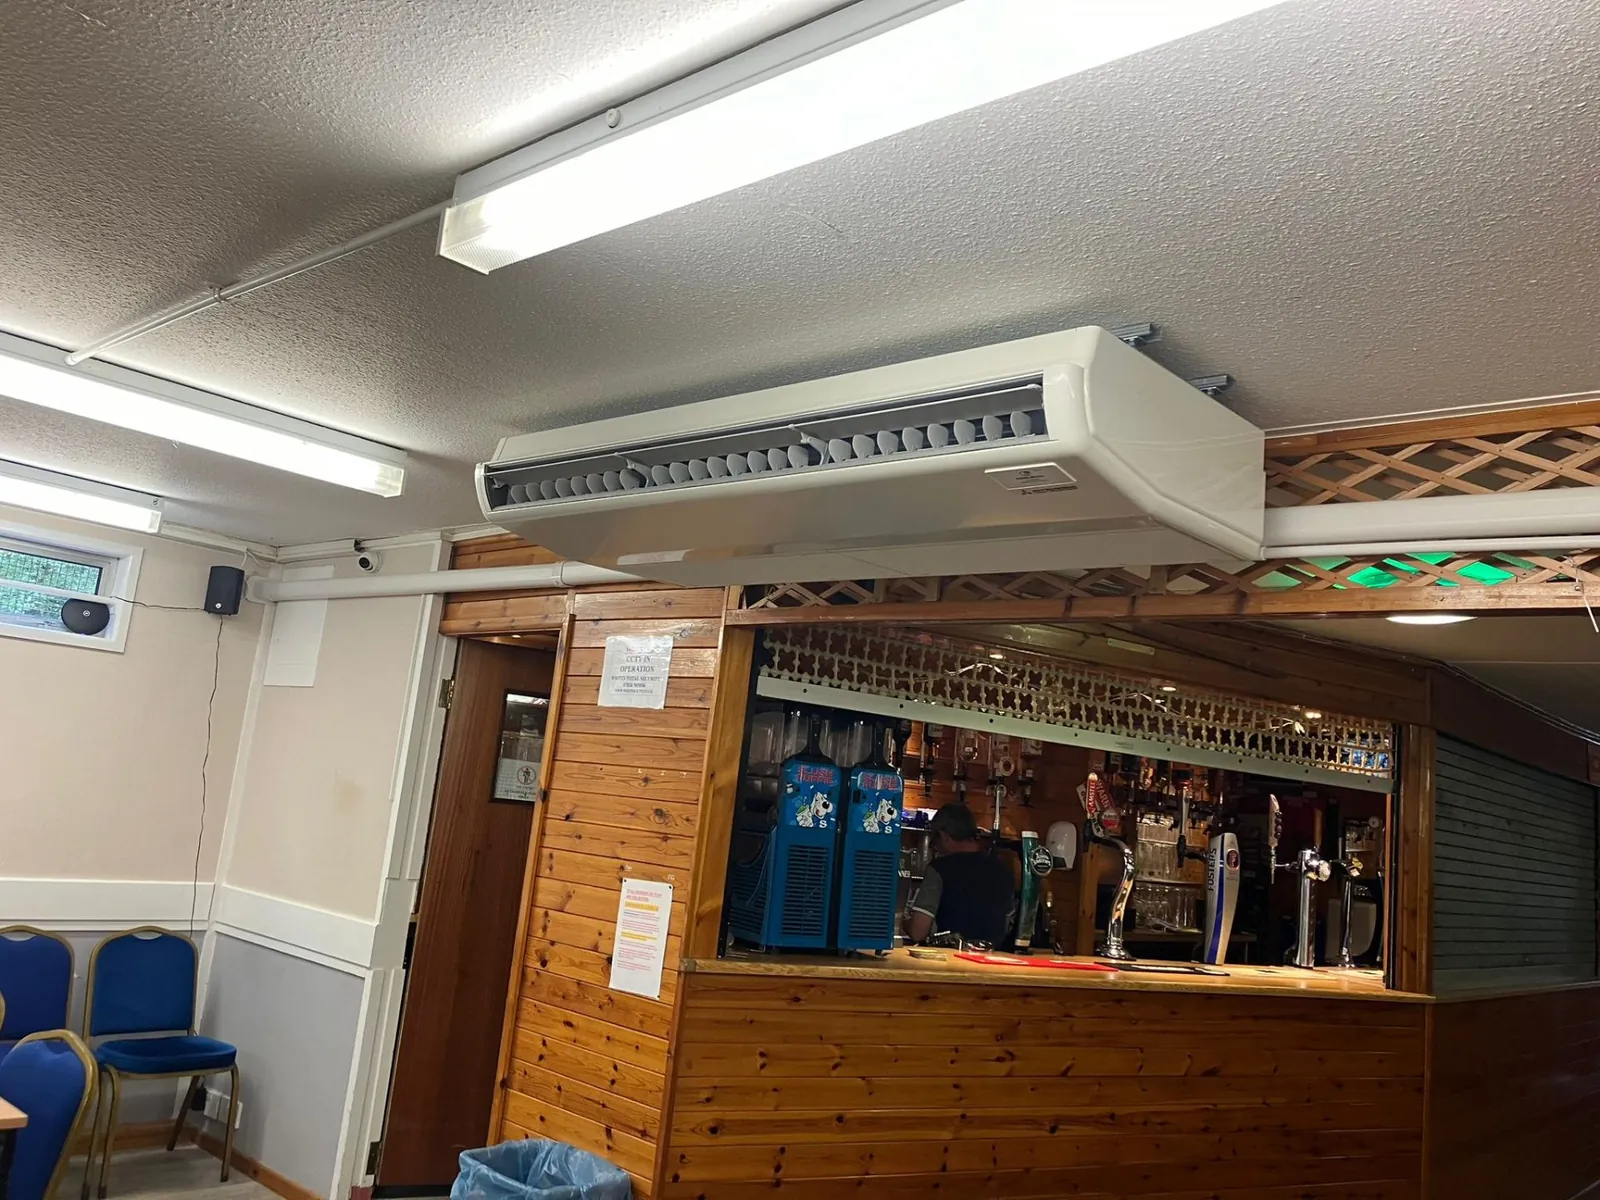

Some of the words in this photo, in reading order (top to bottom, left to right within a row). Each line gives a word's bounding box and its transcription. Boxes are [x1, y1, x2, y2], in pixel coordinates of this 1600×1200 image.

[626, 655, 642, 663] CCTV
[643, 655, 651, 663] IN
[819, 820, 827, 828] S
[884, 826, 892, 834] S
